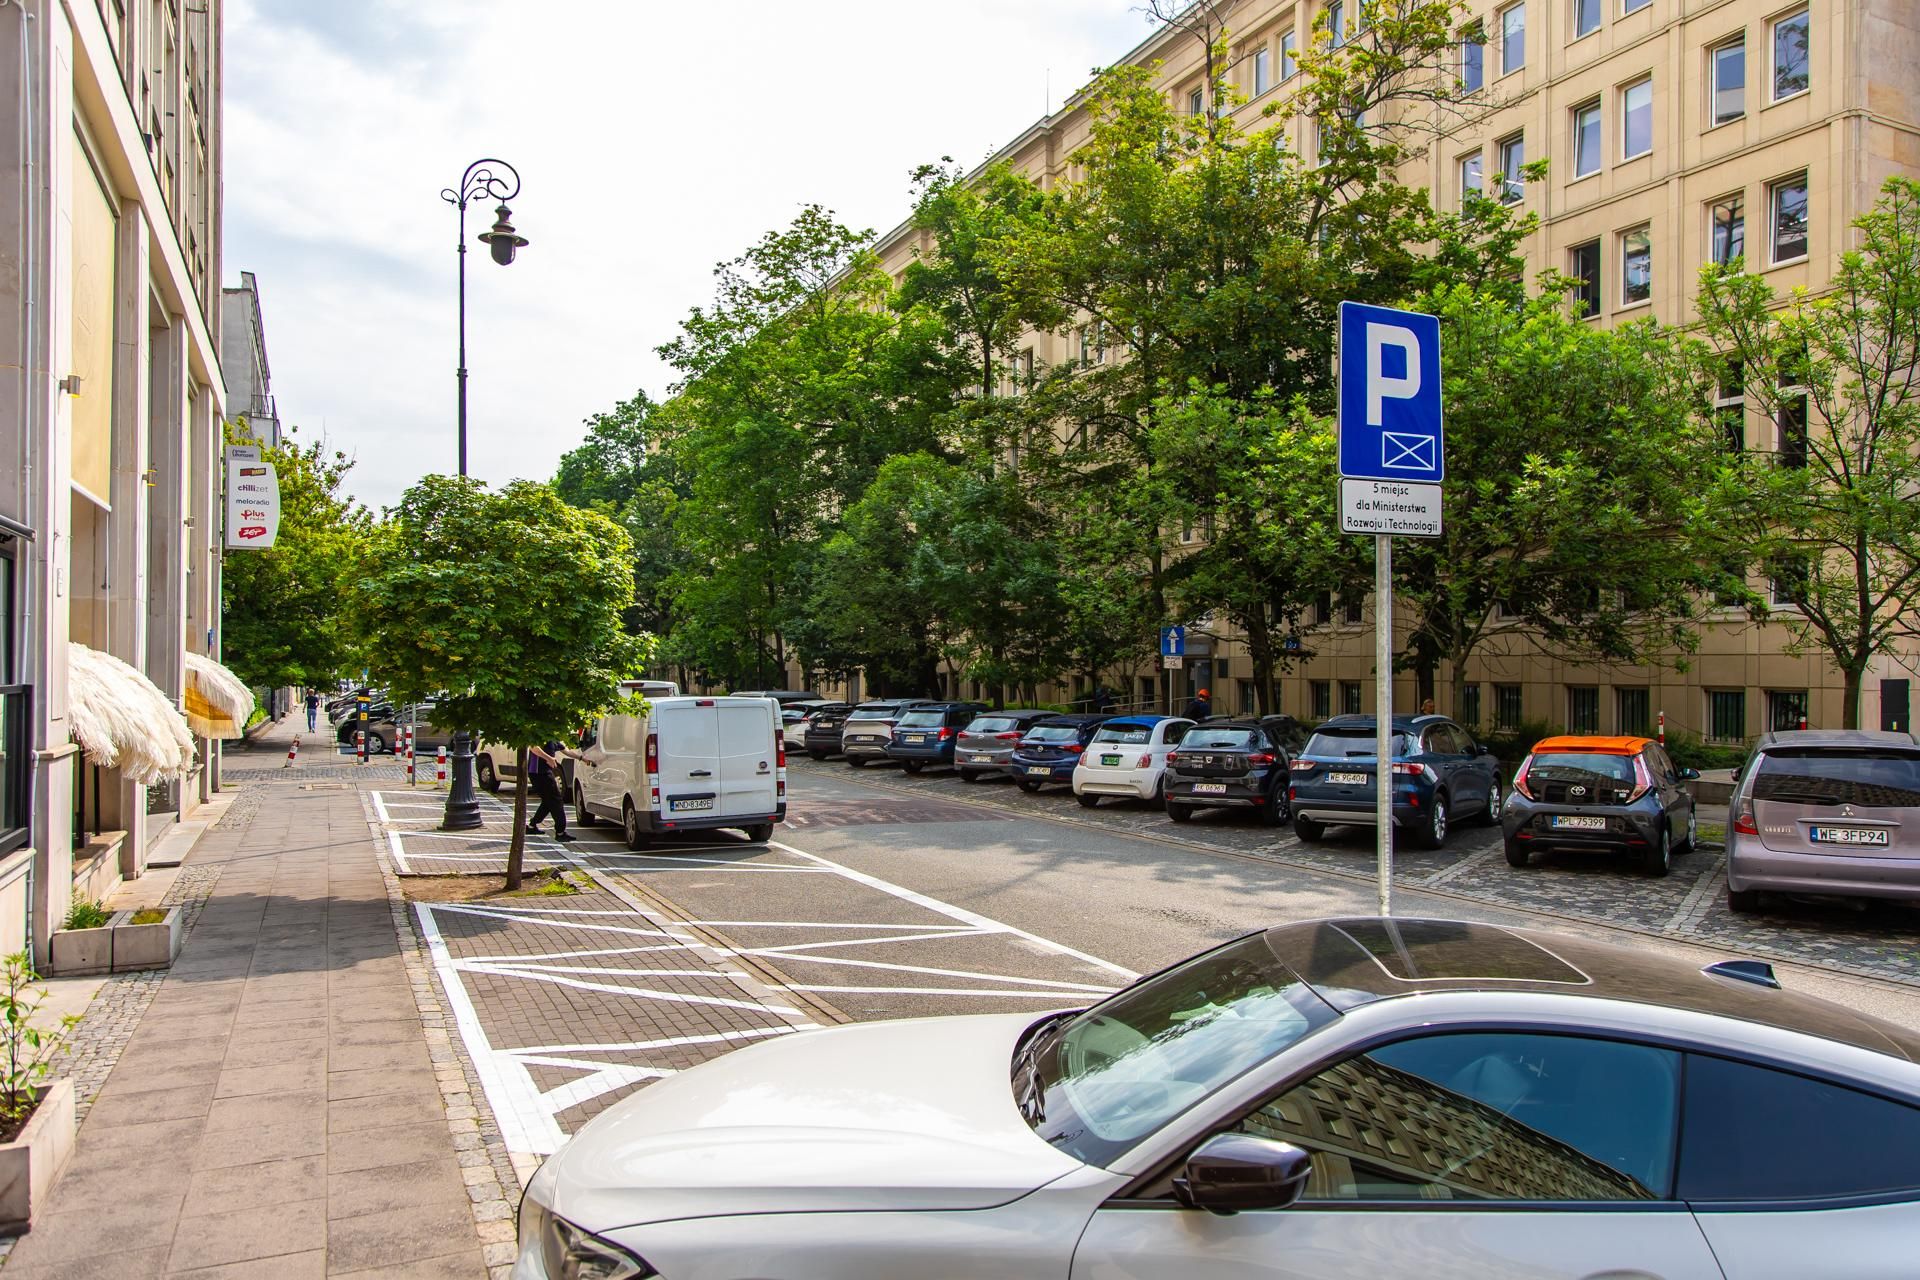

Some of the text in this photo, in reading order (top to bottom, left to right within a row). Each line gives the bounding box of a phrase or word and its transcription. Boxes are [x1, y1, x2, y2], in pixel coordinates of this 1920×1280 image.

[1366, 321, 1421, 426] P
[1373, 483, 1409, 497] 5 miejsc
[235, 498, 270, 506] meloradio
[1356, 500, 1426, 513] dla Ministerstwa
[1347, 516, 1438, 533] Rozwoju i Technologii
[1342, 774, 1365, 782] 9G406
[1558, 816, 1605, 827] WPL 75399
[1819, 828, 1885, 842] WE 3FP94
